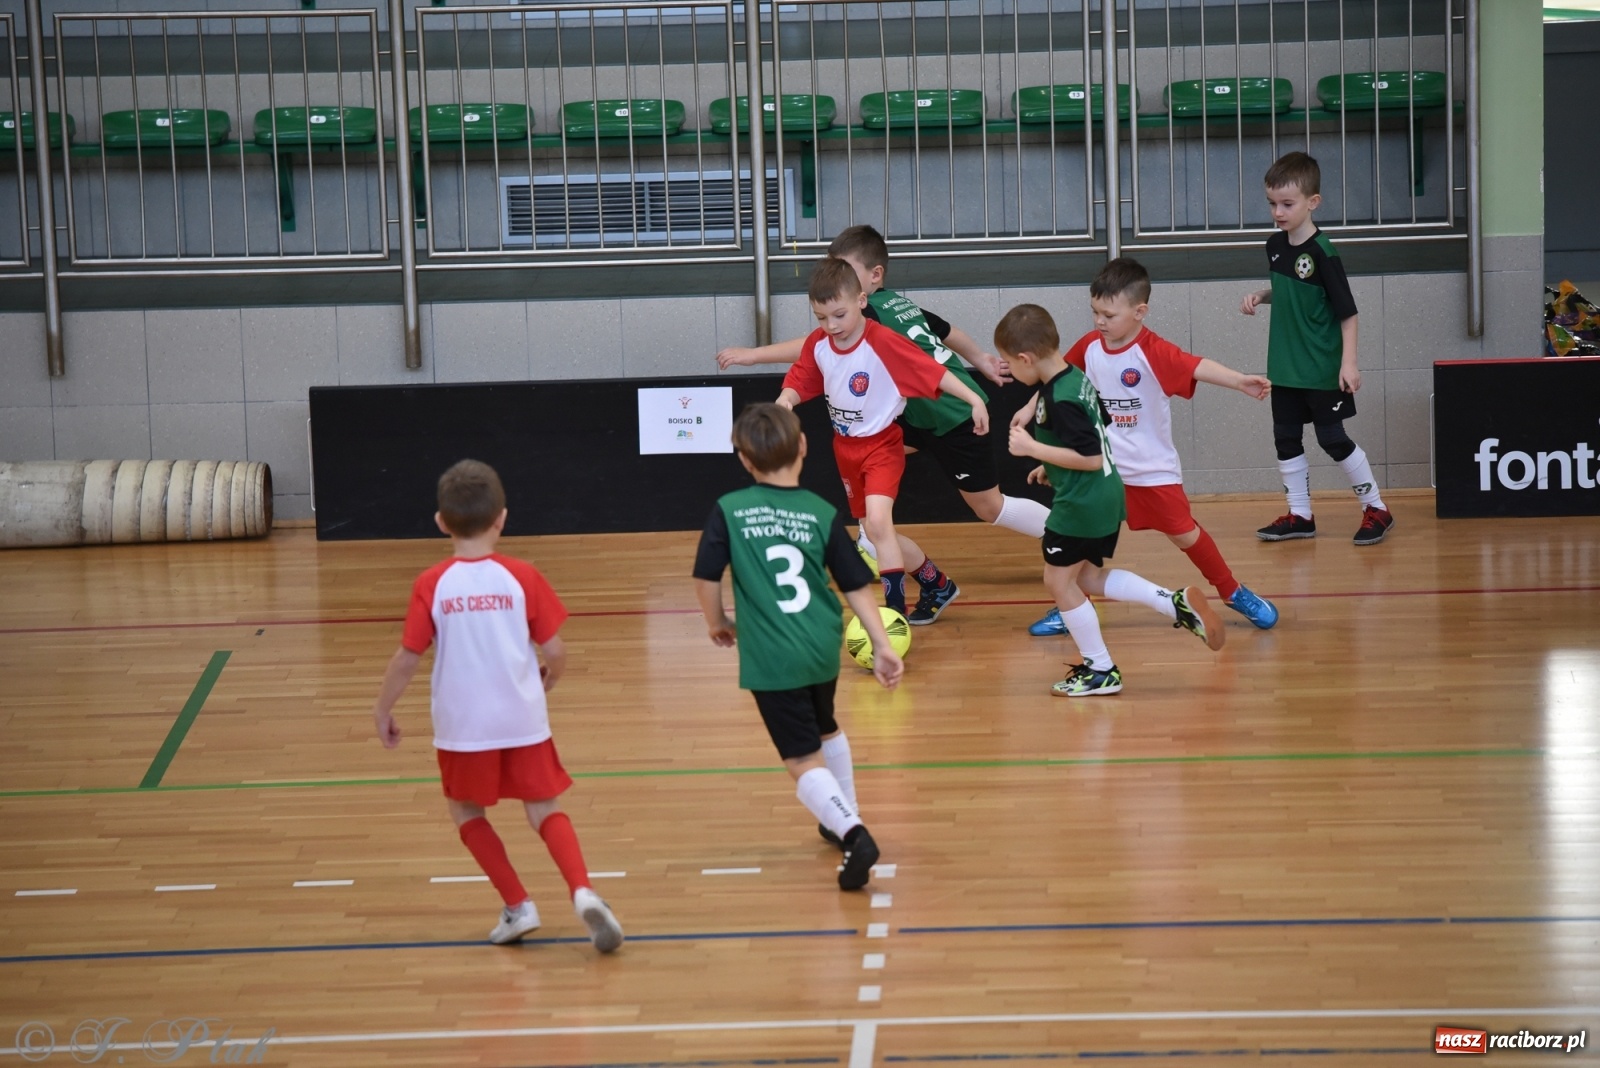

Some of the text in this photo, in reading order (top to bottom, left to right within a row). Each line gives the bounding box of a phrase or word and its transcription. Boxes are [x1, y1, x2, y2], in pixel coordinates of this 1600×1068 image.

[1474, 437, 1600, 491] font
[741, 525, 814, 544] TWORÓW
[765, 543, 811, 614] 3
[441, 594, 513, 615] UKS CIESZYN
